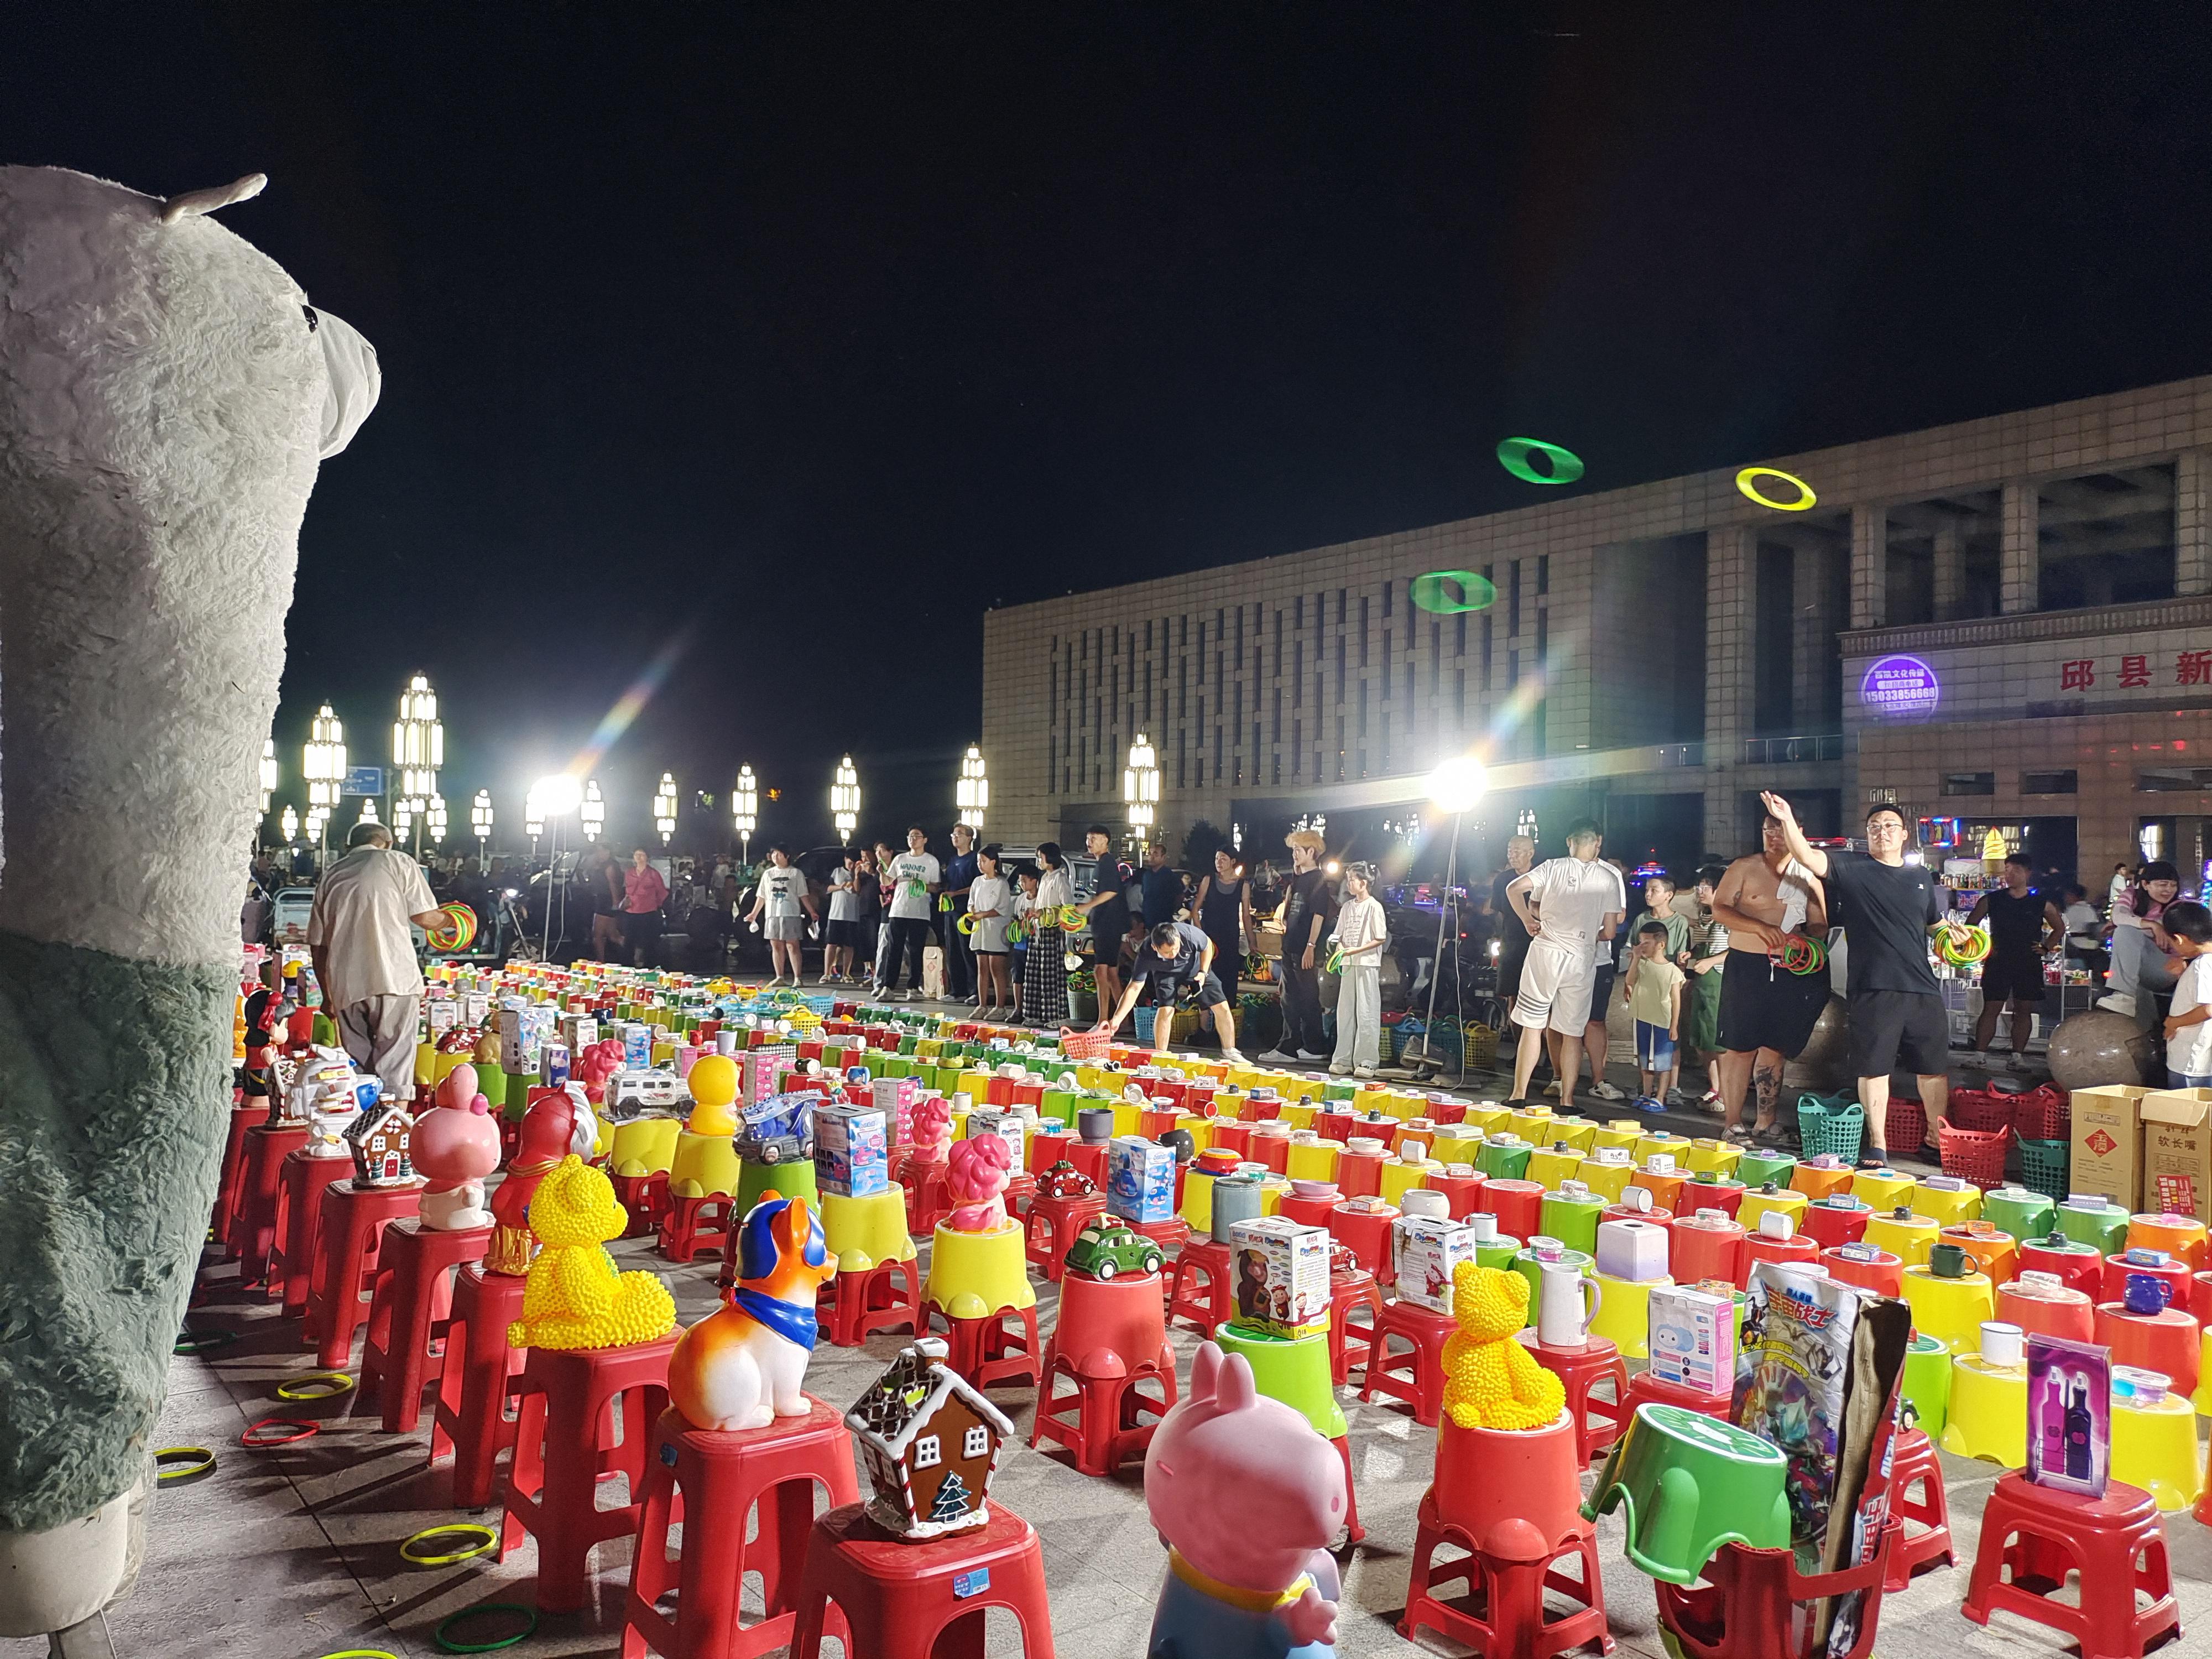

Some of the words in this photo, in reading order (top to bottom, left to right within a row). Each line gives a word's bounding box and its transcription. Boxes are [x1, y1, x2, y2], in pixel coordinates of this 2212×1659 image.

[2158, 1135, 2197, 1151] 软长嘴
[1764, 1282, 1835, 1329] 宇宙战士
